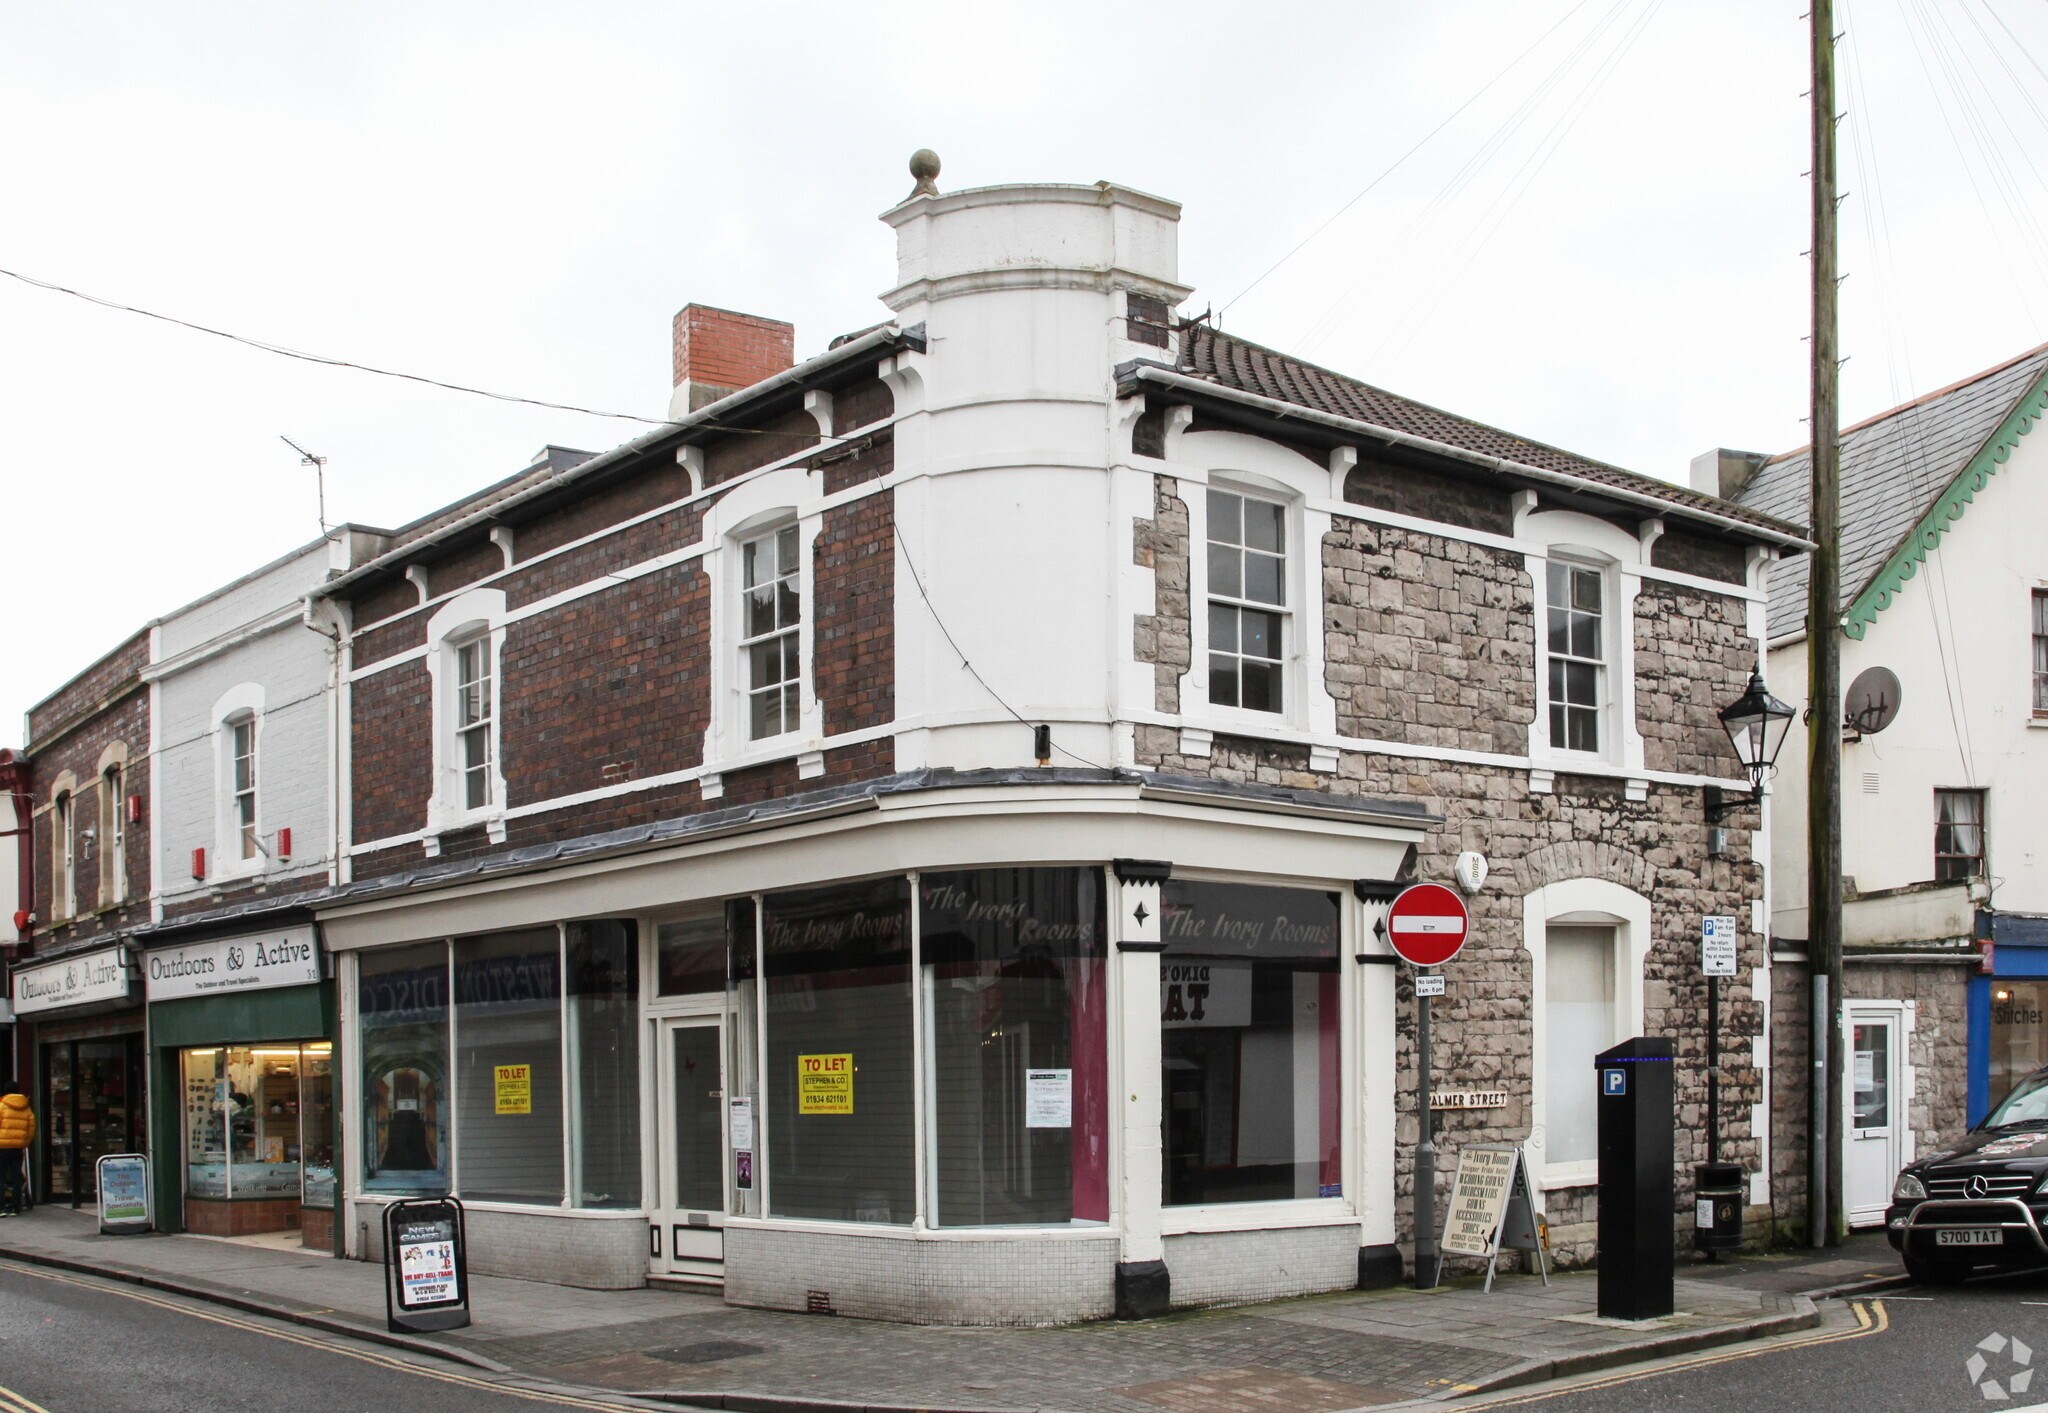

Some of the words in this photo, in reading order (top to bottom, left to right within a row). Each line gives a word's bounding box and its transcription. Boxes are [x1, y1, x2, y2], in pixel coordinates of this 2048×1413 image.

[930, 885, 966, 910] The
[965, 901, 1026, 928] Ivory
[1018, 918, 1092, 941] Rooms
[771, 919, 798, 947] The
[804, 919, 844, 951] Ivory
[851, 912, 902, 939] Rooms
[1168, 909, 1205, 937] The
[1212, 913, 1264, 948] Ivory
[1270, 916, 1330, 944] Rooms
[151, 953, 215, 980] Outdoors
[227, 946, 245, 971] &
[255, 938, 310, 967] Active
[66, 966, 78, 991] &
[804, 1059, 821, 1071] TO
[825, 1058, 846, 1071] LET
[499, 1069, 510, 1079] TO
[511, 1068, 526, 1079] LET
[1610, 1073, 1622, 1090] P
[806, 1095, 824, 1103] 01934
[1430, 1094, 1465, 1106] ALMER
[1470, 1093, 1506, 1105] STREET
[1473, 1150, 1491, 1166] Ivory
[1492, 1152, 1510, 1165] Room
[1461, 1165, 1480, 1173] Designer
[1459, 1173, 1484, 1186] WEDDING
[1485, 1175, 1505, 1187] GOWNS
[1459, 1185, 1498, 1199] BRIDESMAIDS
[1466, 1198, 1486, 1210] GOWNS
[1455, 1210, 1492, 1223] ACCESSORIES
[408, 1226, 435, 1235] NEW
[1461, 1222, 1480, 1234] SHOES
[400, 1232, 439, 1242] GAMES
[1941, 1231, 1970, 1243] S700
[1974, 1230, 1998, 1243] TAT
